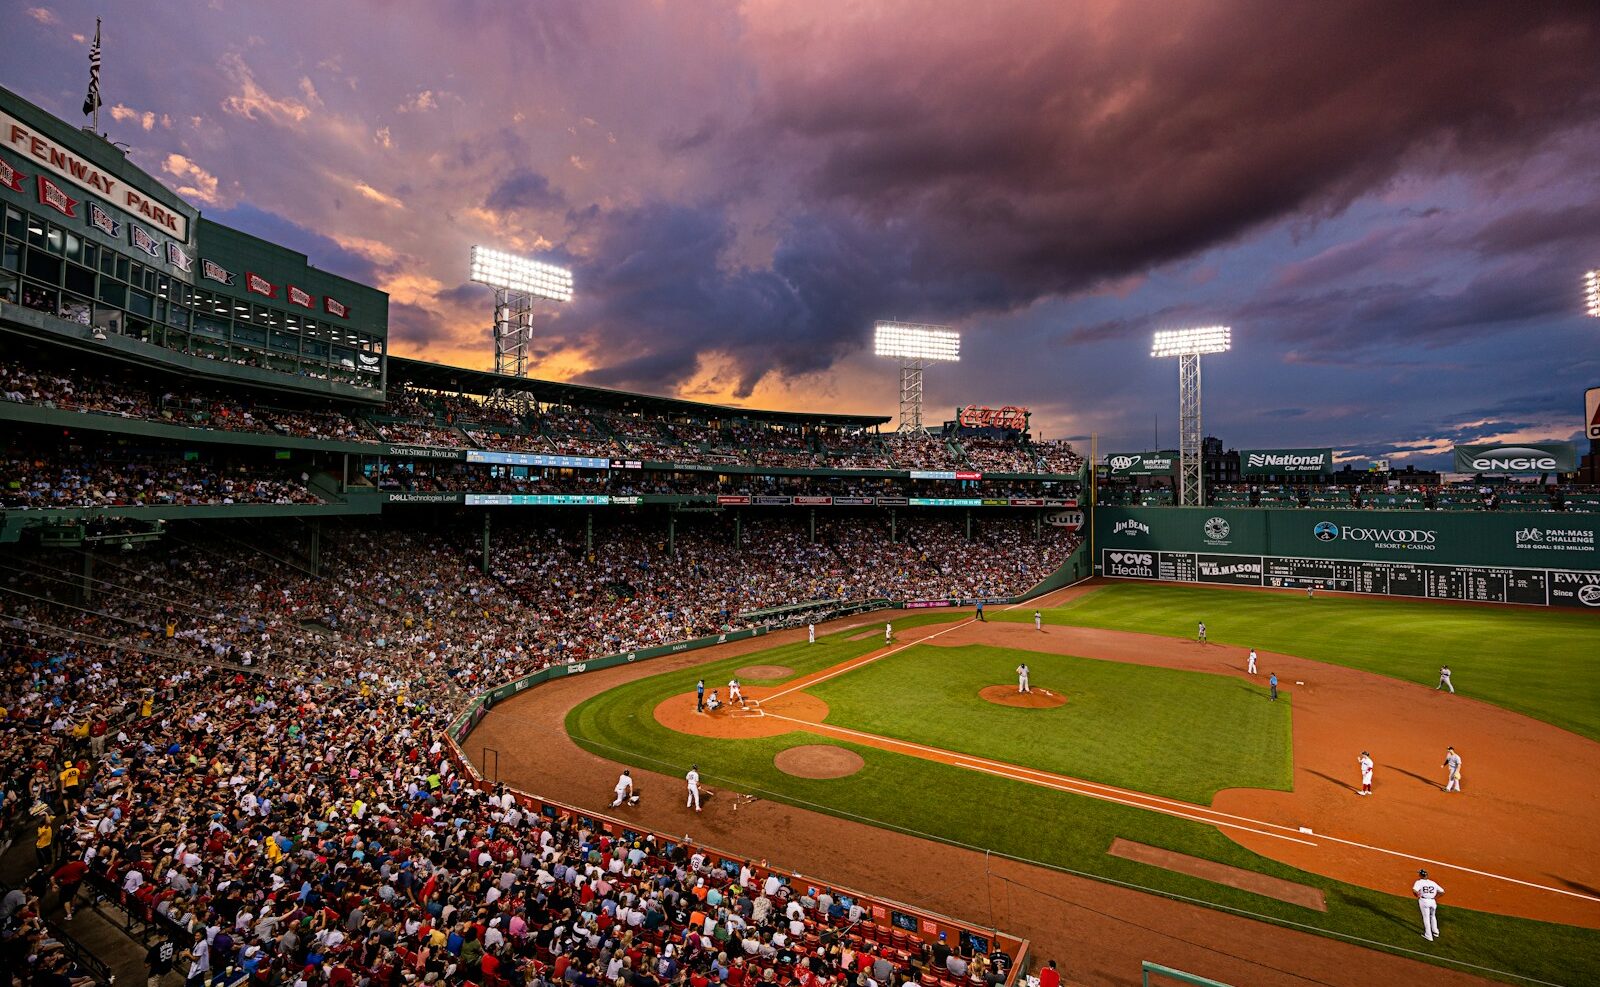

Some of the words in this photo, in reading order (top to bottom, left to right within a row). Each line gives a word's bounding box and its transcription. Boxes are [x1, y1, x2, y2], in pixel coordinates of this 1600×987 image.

[11, 125, 115, 194] FENWAY
[127, 191, 177, 231] PARK
[390, 447, 409, 455] STATE
[409, 448, 430, 456] STREET
[432, 449, 458, 458] PAVILION
[1265, 454, 1324, 465] National
[407, 494, 442, 502] Technologies
[1047, 513, 1080, 523] Gulf
[1113, 521, 1127, 533] JIM
[1128, 519, 1149, 534] BEAM
[1342, 526, 1435, 543] FOXWOODS
[1124, 553, 1152, 565] CVS
[1111, 564, 1153, 576] Health
[1554, 573, 1583, 584] F.W.
[160, 948, 173, 962] 99
